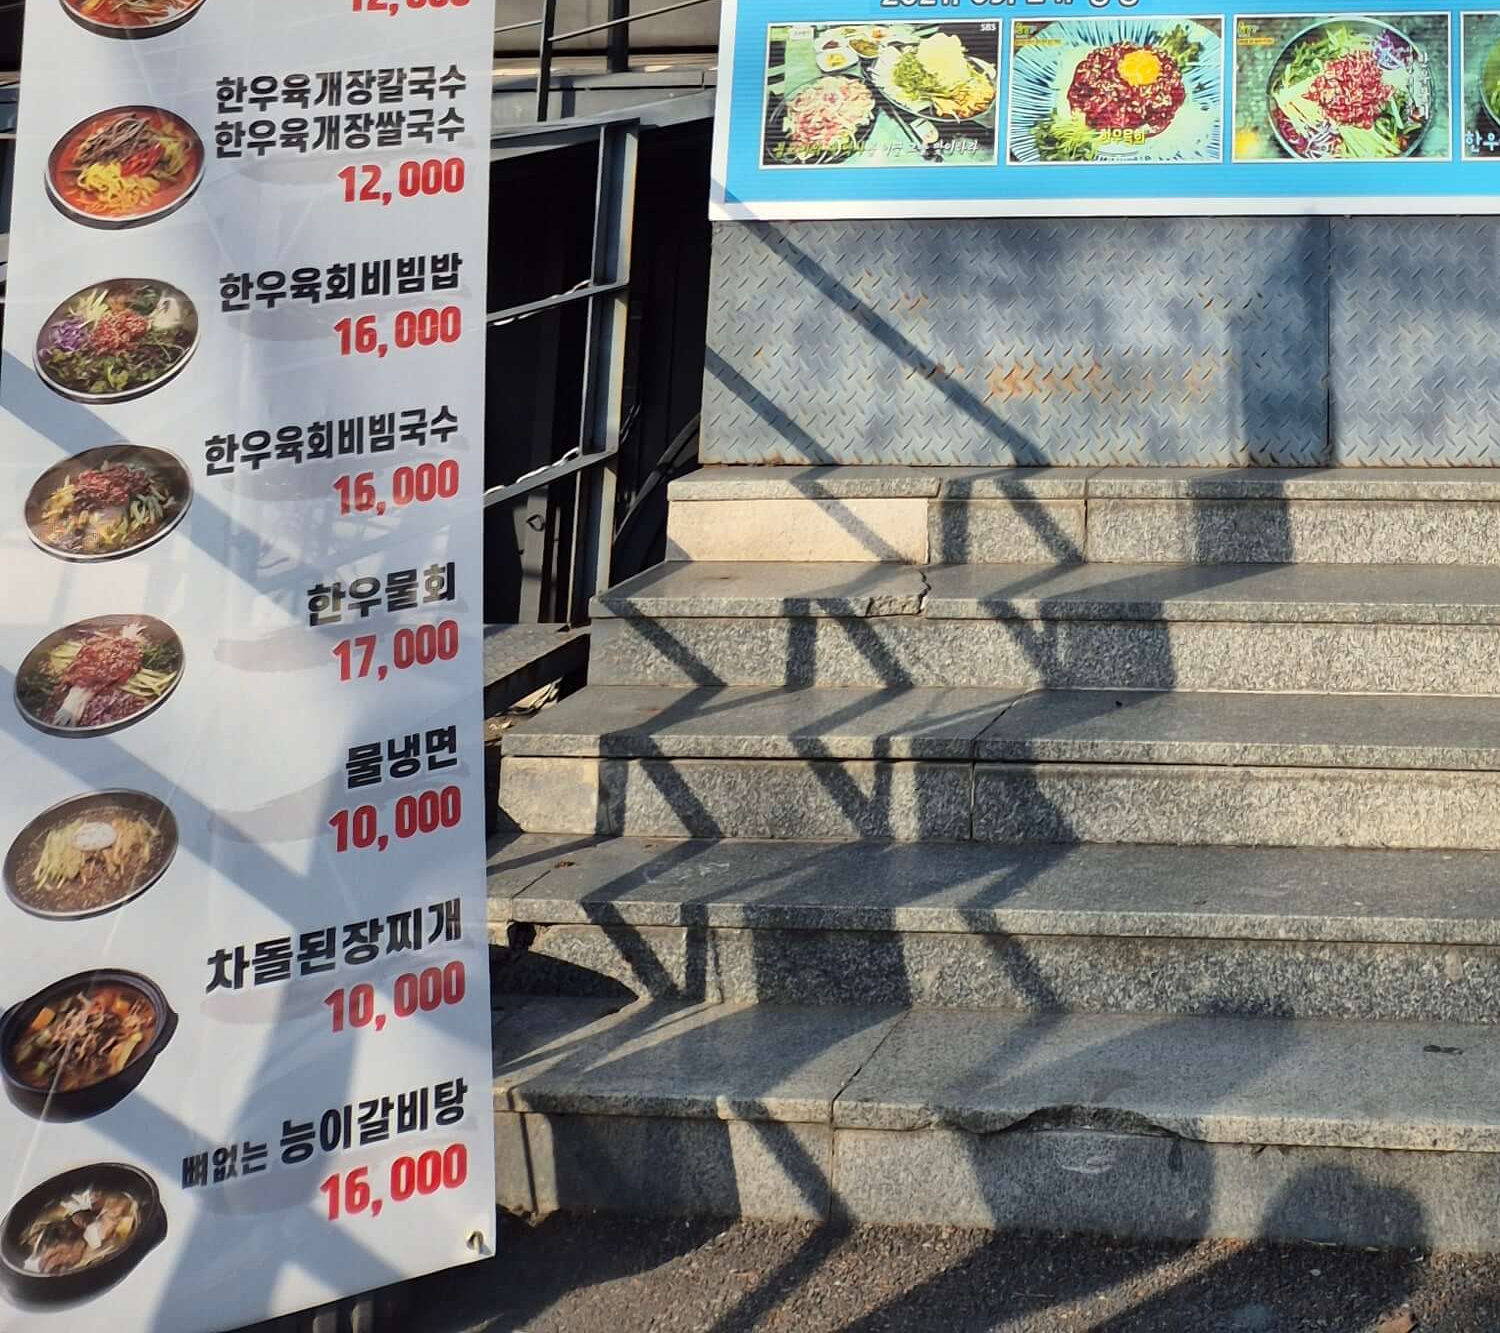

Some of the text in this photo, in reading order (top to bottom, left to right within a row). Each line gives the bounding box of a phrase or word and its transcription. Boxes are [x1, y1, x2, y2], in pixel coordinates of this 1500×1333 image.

[216, 62, 467, 114] 한우육개장칼국수
[214, 107, 465, 159] 한우육개장쌀국수
[338, 157, 465, 204] 12,000
[219, 252, 463, 313] 한우육회비빔밥
[333, 307, 461, 358] 16,000
[205, 404, 459, 476] 한우육회비빔국수
[333, 460, 458, 515] 16,000
[306, 562, 457, 628] 한우물회
[332, 619, 458, 683] 17,000
[346, 725, 458, 789] 물냉면
[329, 785, 462, 854] 10,000
[206, 898, 462, 995] 차돌된장찌개
[324, 960, 466, 1033] 10,000
[181, 1077, 468, 1190] 뼈없는 능이갈비탕
[320, 1142, 468, 1222] 16,000
